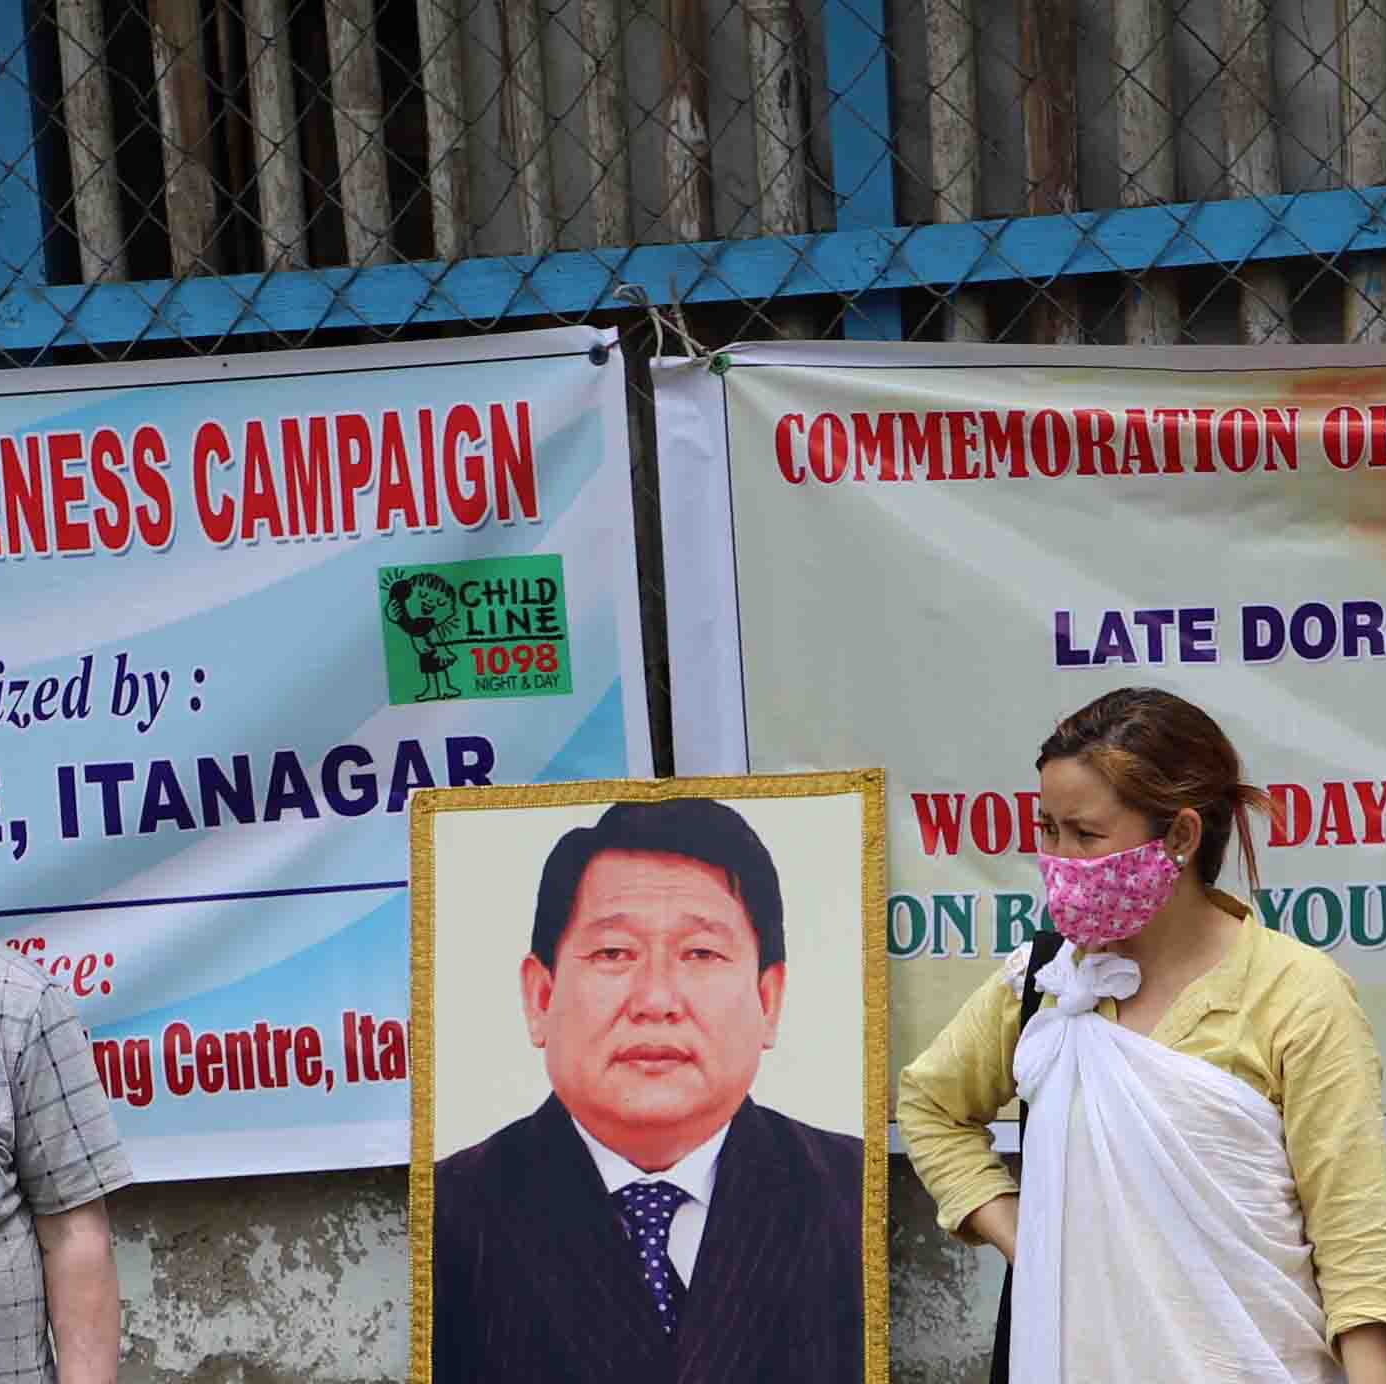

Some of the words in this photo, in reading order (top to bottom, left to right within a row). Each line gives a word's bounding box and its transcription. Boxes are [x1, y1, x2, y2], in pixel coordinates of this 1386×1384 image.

[191, 401, 539, 545] CAMPAIGN
[774, 407, 1300, 485] COMMEMORATION
[459, 577, 557, 607] CHILD
[466, 606, 560, 636] LINE
[469, 643, 559, 676] 1098
[1054, 607, 1218, 668] LATE
[111, 653, 170, 733] by
[475, 676, 518, 692] NIGHT
[534, 674, 560, 689] DAY
[56, 735, 496, 839] ITANAGAR
[163, 1020, 335, 1095] Centre,
[344, 1010, 410, 1083] Ita
